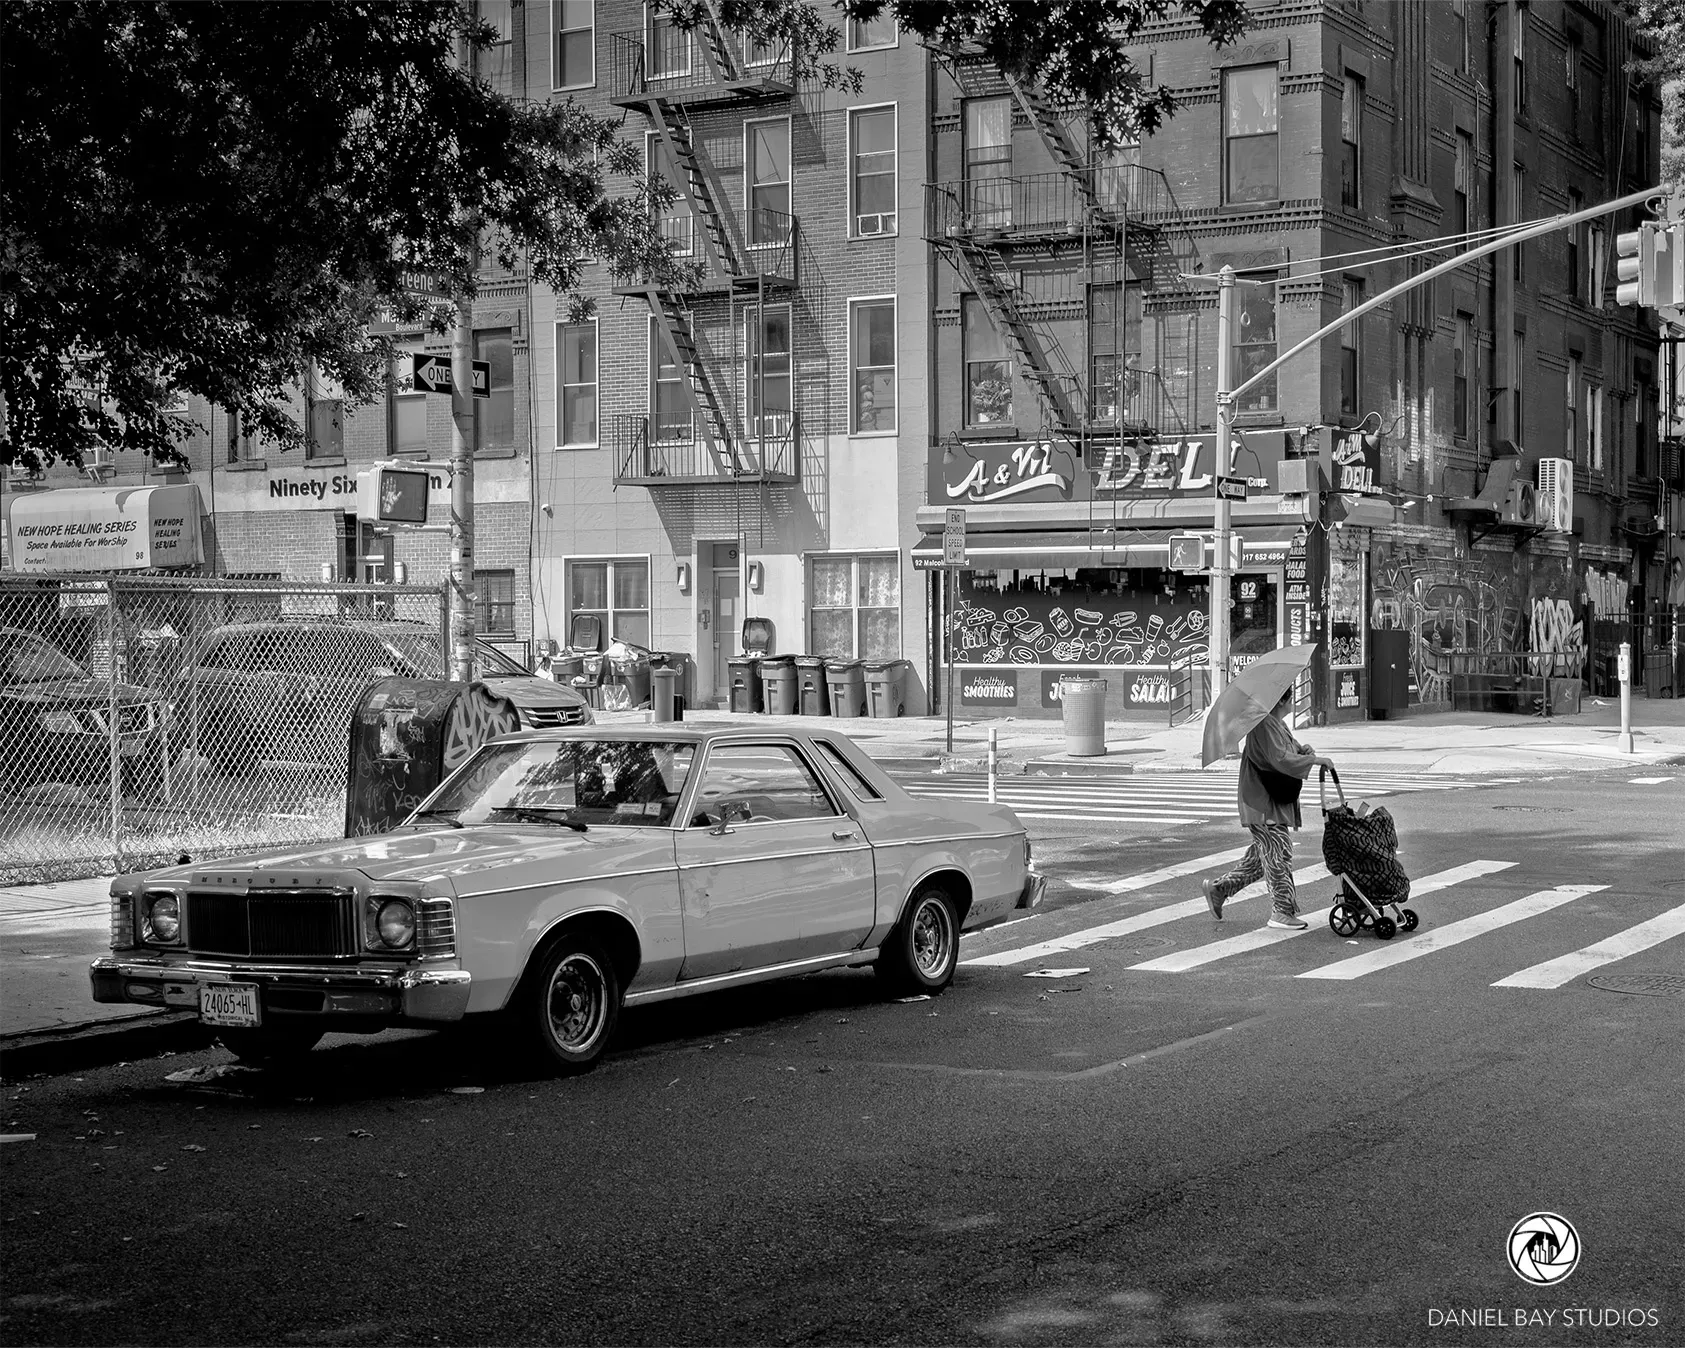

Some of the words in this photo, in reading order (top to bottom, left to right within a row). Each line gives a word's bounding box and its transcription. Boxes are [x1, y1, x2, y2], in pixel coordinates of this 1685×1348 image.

[402, 271, 433, 291] reene
[428, 367, 451, 383] ONE
[1247, 476, 1269, 488] Corp.
[270, 478, 327, 500] Ninety
[1221, 484, 1231, 494] ONE
[1234, 486, 1244, 495] WAY
[153, 519, 167, 527] NEW
[167, 518, 184, 526] HOPE
[951, 514, 961, 523] END
[17, 526, 37, 537] NEW
[37, 525, 63, 536] HOPE
[64, 522, 102, 535] HEALING
[103, 521, 137, 533] SERIES
[155, 529, 181, 537] HEALING
[946, 526, 964, 535] SCHOOL
[26, 541, 49, 551] Space
[50, 539, 82, 549] Available
[83, 537, 97, 547] For
[155, 540, 177, 549] SERIES
[948, 539, 963, 547] SPEED
[135, 551, 144, 560] 98
[1289, 547, 1306, 556] ARDS
[915, 559, 923, 567] 92
[1286, 561, 1307, 570] HALAL
[1287, 570, 1306, 579] FOOD
[1241, 582, 1257, 596] 92
[1289, 585, 1303, 593] ATM
[1286, 592, 1306, 600] INSIDE
[1290, 608, 1302, 646] ODUCTS
[1233, 655, 1259, 666] WELCO
[973, 676, 1006, 687] Healthy
[1136, 674, 1169, 686] Healthy
[963, 685, 1015, 698] SMOOTHIES
